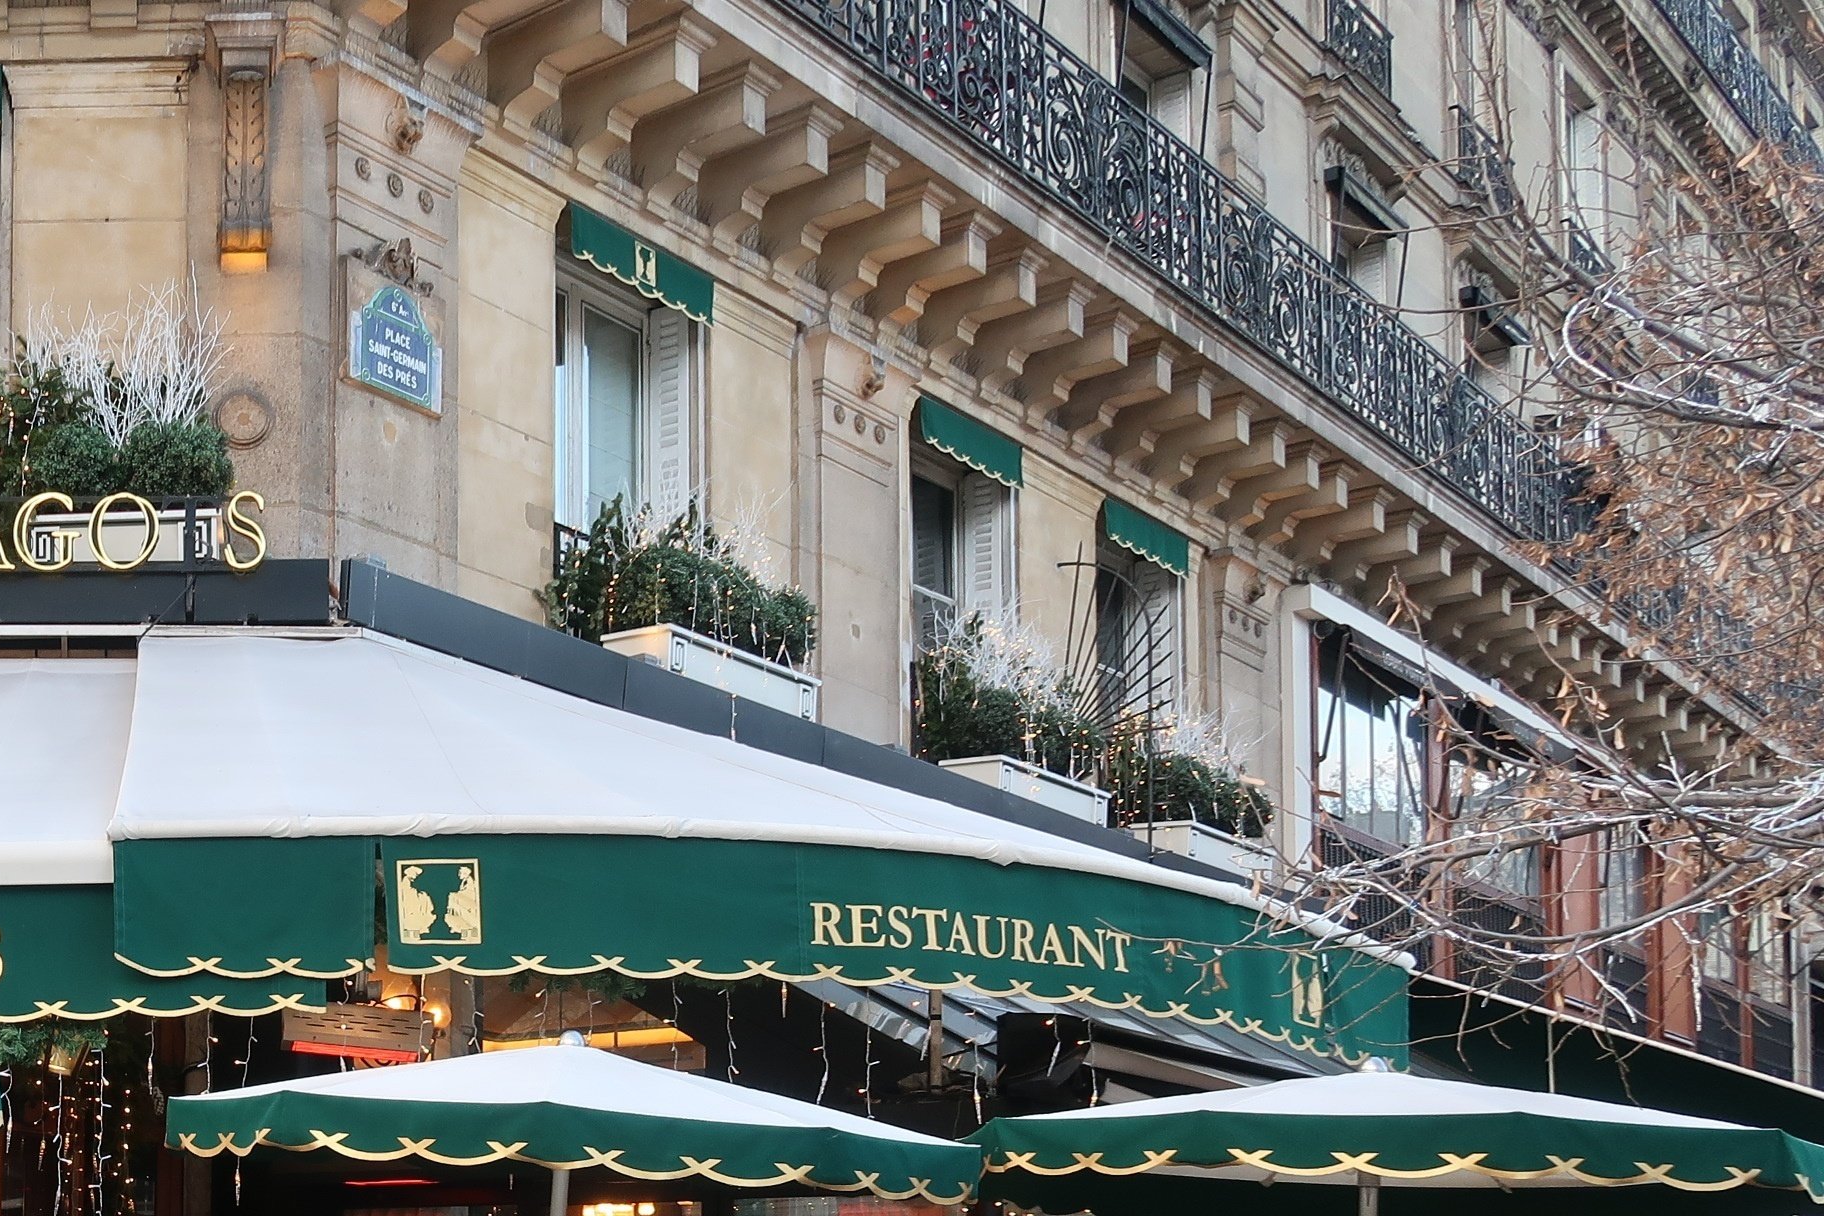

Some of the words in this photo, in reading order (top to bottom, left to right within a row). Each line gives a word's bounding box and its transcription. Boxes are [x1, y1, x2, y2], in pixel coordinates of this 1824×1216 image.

[385, 327, 411, 350] PLACE
[368, 339, 427, 375] SAINT-GERMAIN
[377, 361, 393, 379] DES
[395, 367, 417, 389] PRÉS
[809, 901, 1131, 973] RESTAURANT
